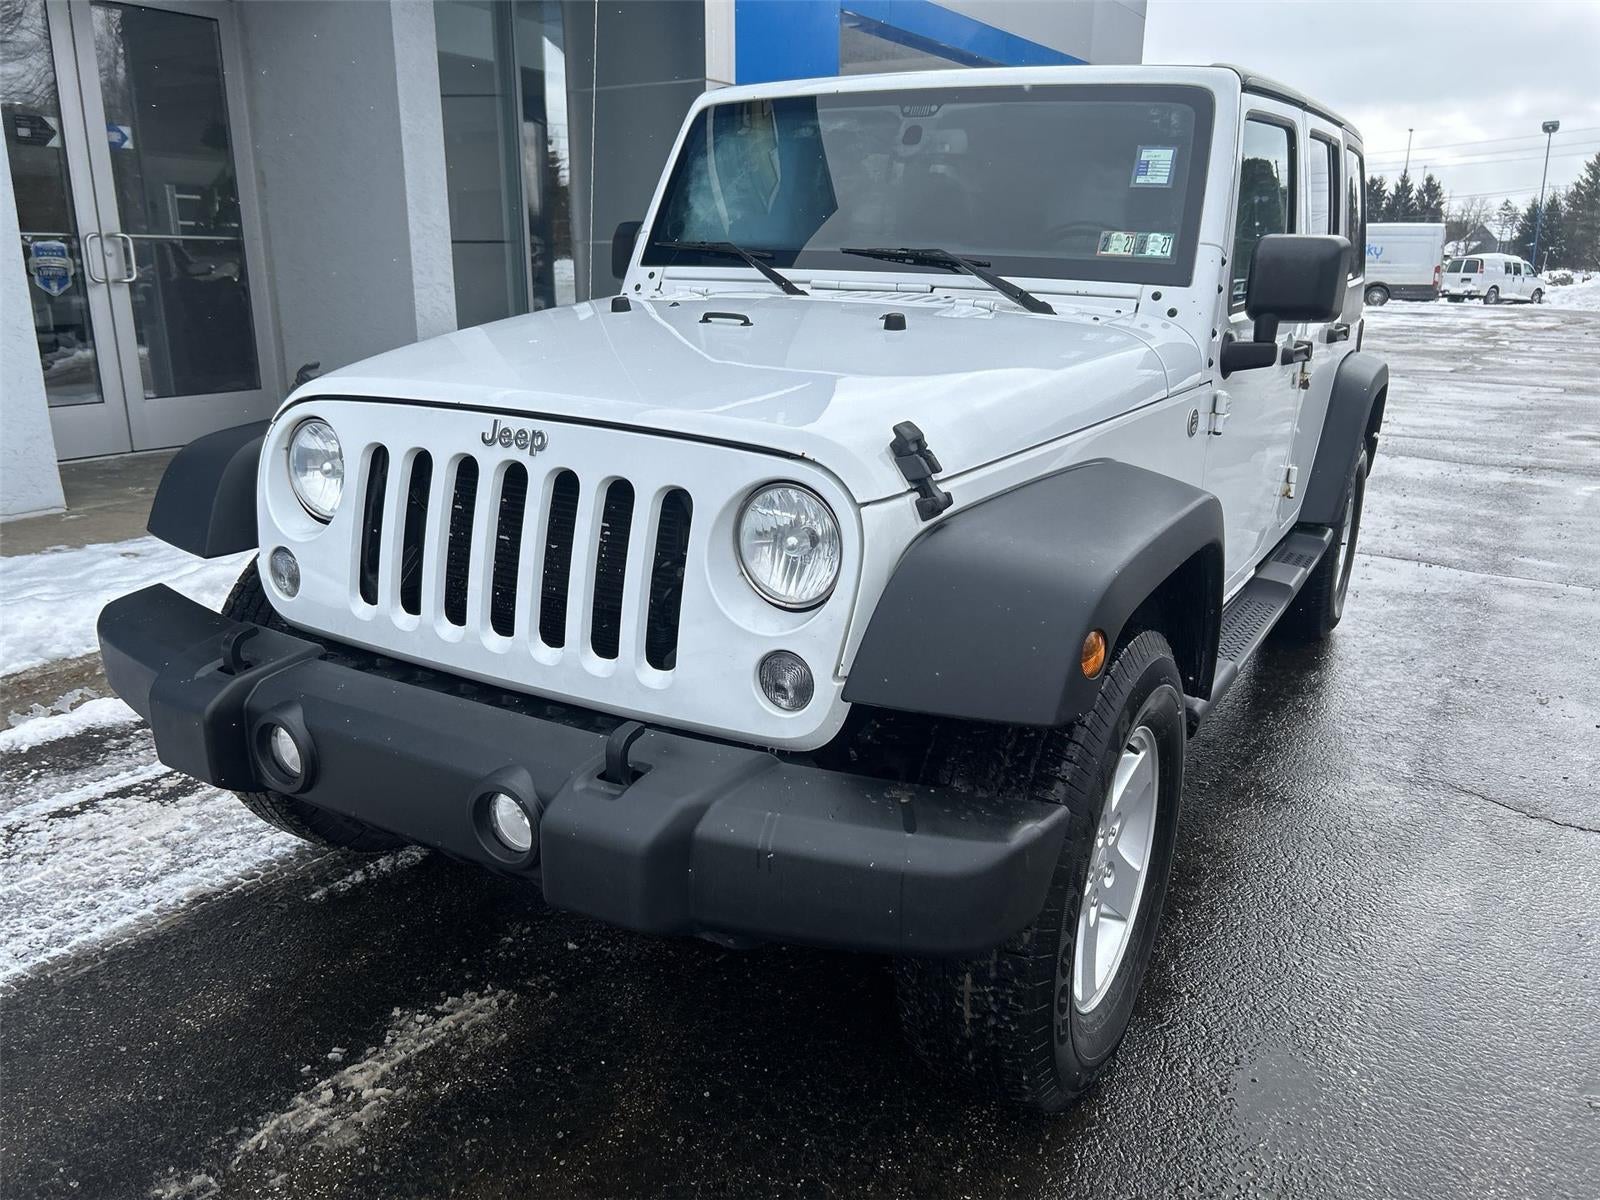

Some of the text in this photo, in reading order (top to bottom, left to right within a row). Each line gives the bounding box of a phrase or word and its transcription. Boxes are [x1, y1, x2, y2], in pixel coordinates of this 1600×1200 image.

[1123, 235, 1134, 254] 27
[1160, 236, 1172, 254] 27
[1366, 243, 1383, 259] ky
[481, 418, 548, 457] Jeep
